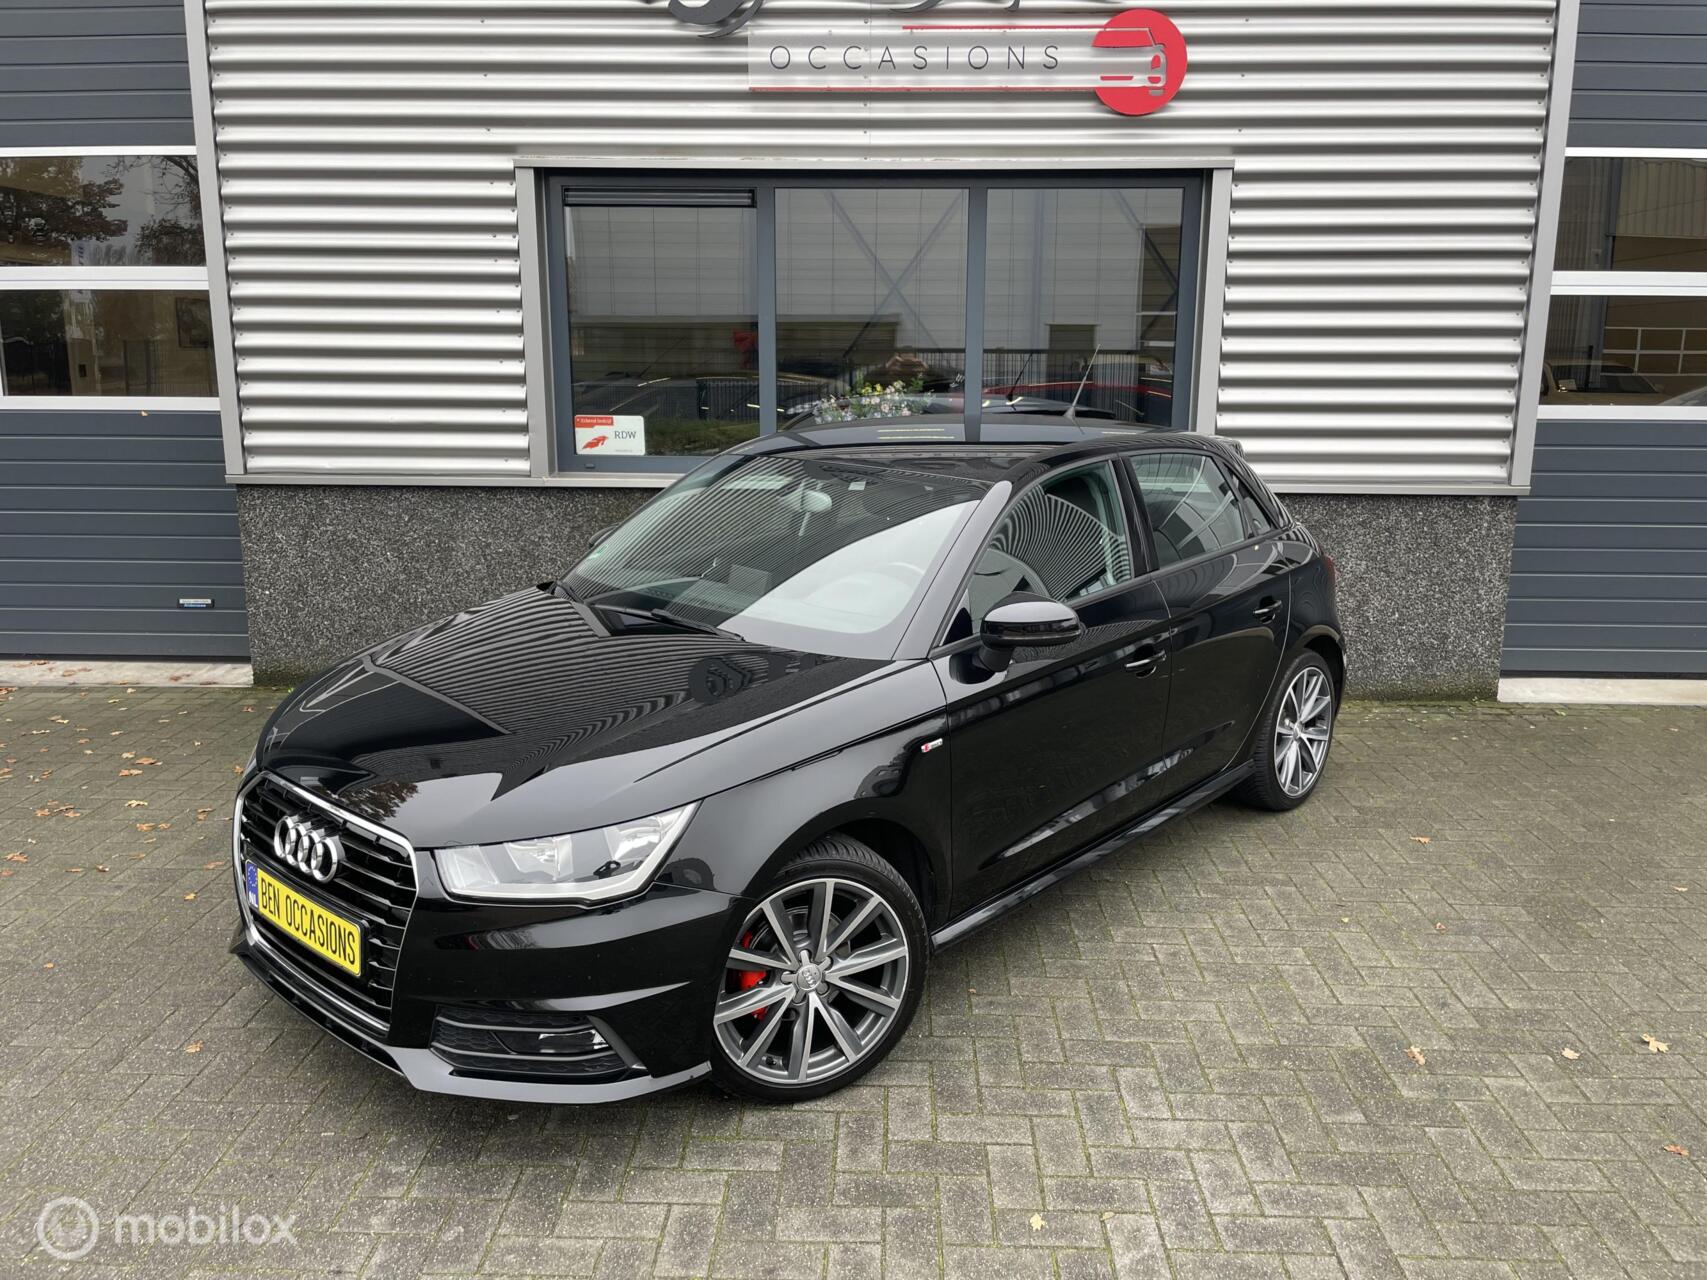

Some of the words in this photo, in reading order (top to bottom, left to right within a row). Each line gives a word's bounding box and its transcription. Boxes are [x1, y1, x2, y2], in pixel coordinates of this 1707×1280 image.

[769, 45, 1060, 71] OCCASIONS
[614, 431, 636, 439] RDW
[261, 877, 281, 920] BEN
[285, 895, 355, 965] OCCASIONS
